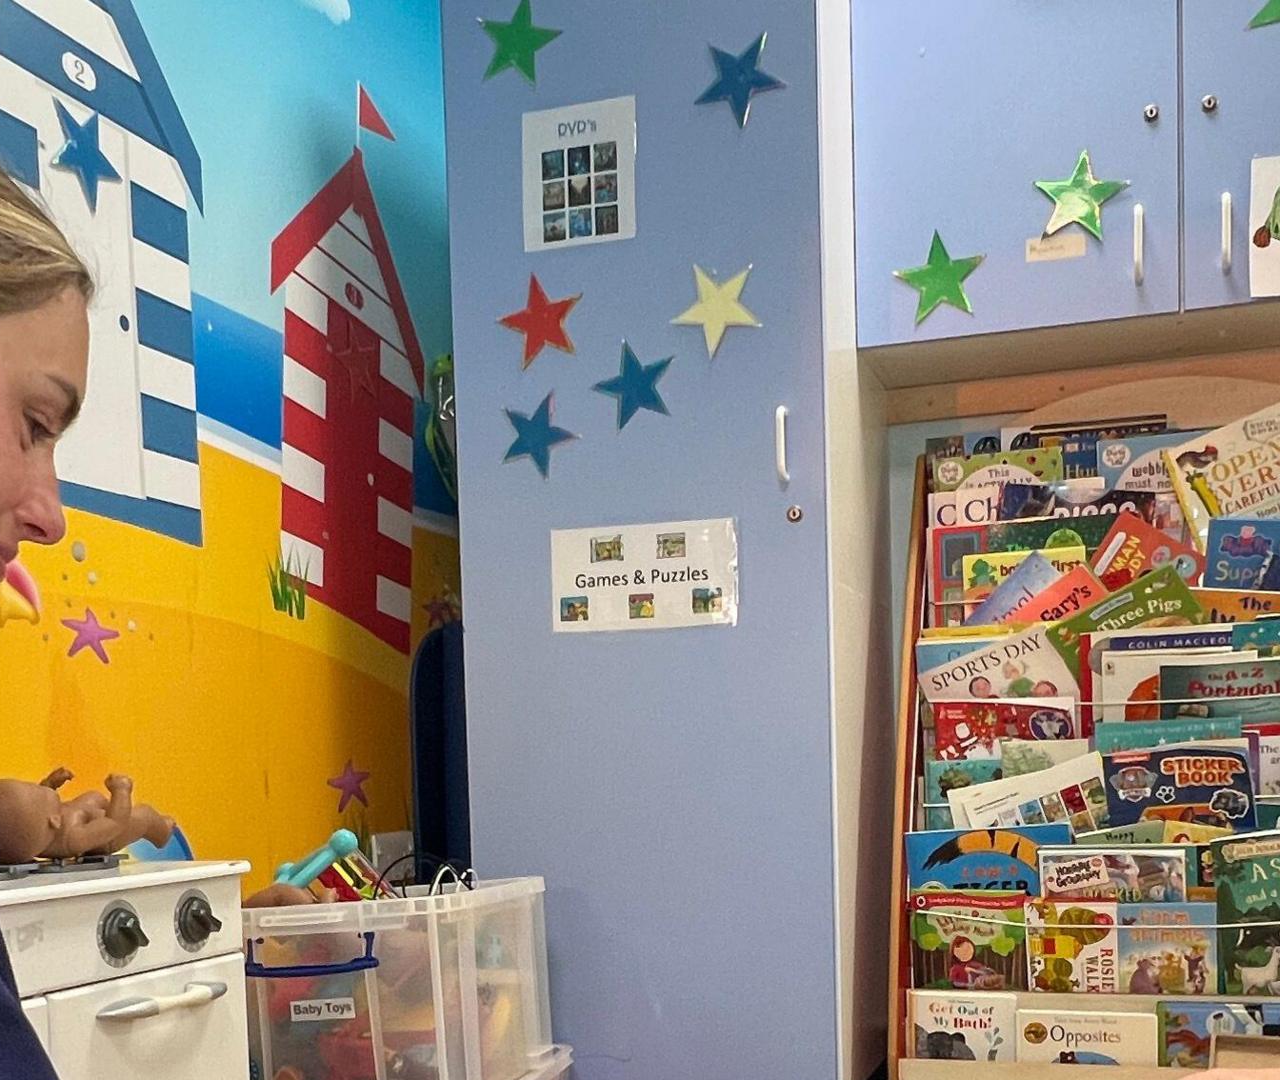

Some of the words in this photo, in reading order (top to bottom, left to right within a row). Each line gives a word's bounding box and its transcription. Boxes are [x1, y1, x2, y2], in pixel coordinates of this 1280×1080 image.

[73, 59, 87, 85] 2
[558, 119, 597, 138] DVD's
[988, 469, 1010, 478] This
[1125, 479, 1151, 489] must
[1157, 480, 1173, 489] no
[937, 504, 957, 527] C
[964, 497, 1001, 523] Ch
[1109, 535, 1141, 573] MAN
[575, 573, 629, 589] Games
[633, 569, 646, 585] &
[651, 566, 709, 584] Puzzles
[1000, 564, 1017, 577] bo
[1215, 561, 1256, 583] Sup
[1239, 596, 1272, 611] The
[1098, 606, 1144, 632] Three
[1147, 598, 1182, 617] Pigs
[1128, 639, 1167, 650] COLIN
[931, 650, 1002, 691] SPORTS
[1004, 632, 1042, 659] DAY
[1260, 744, 1279, 754] The
[1162, 758, 1241, 773] STICKER
[1177, 771, 1230, 786] BOOK
[1251, 863, 1268, 883] A
[1245, 888, 1267, 904] and
[1270, 889, 1278, 898] a
[1085, 955, 1100, 993] WALK
[293, 1004, 322, 1016] Baby
[325, 1003, 352, 1015] Toys
[929, 1001, 953, 1016] Get
[957, 1003, 979, 1016] Out
[982, 1005, 995, 1015] of
[933, 1016, 949, 1029] My
[953, 1016, 992, 1029] Bath!
[1050, 1024, 1121, 1048] Opposites
